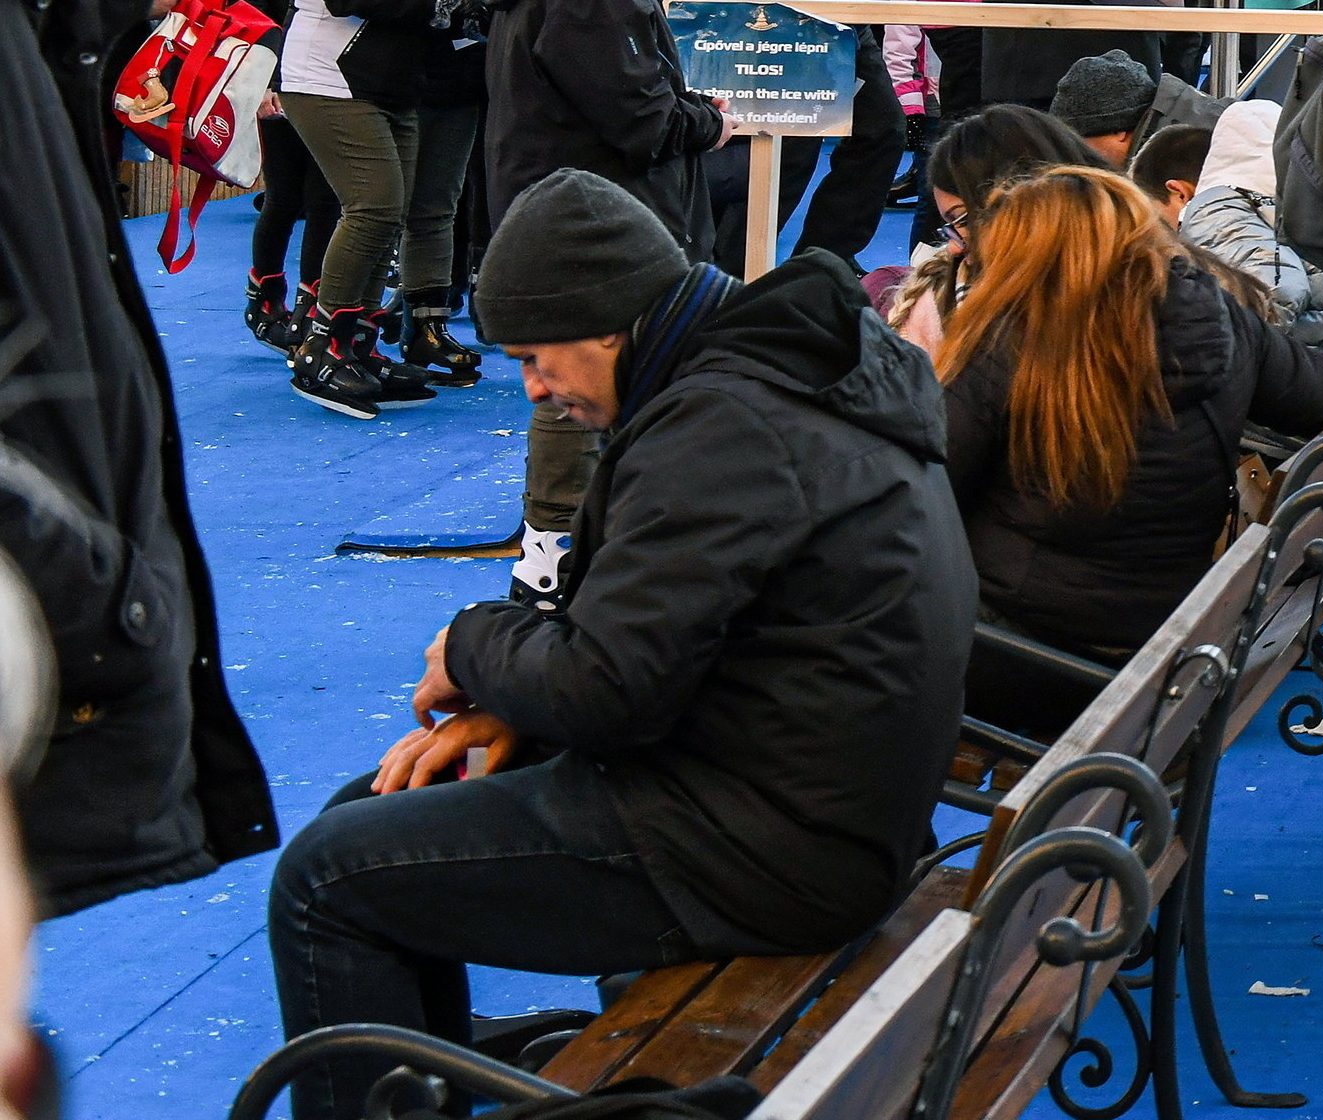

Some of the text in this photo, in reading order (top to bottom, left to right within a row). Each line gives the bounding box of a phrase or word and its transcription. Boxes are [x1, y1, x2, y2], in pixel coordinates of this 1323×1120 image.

[694, 39, 828, 55] Cipővel a jégre lépni
[735, 64, 784, 76] TILOS!
[704, 87, 734, 100] step
[736, 90, 754, 100] on
[756, 88, 779, 100] the
[781, 89, 802, 100] ice
[747, 111, 817, 124] forbidden!
